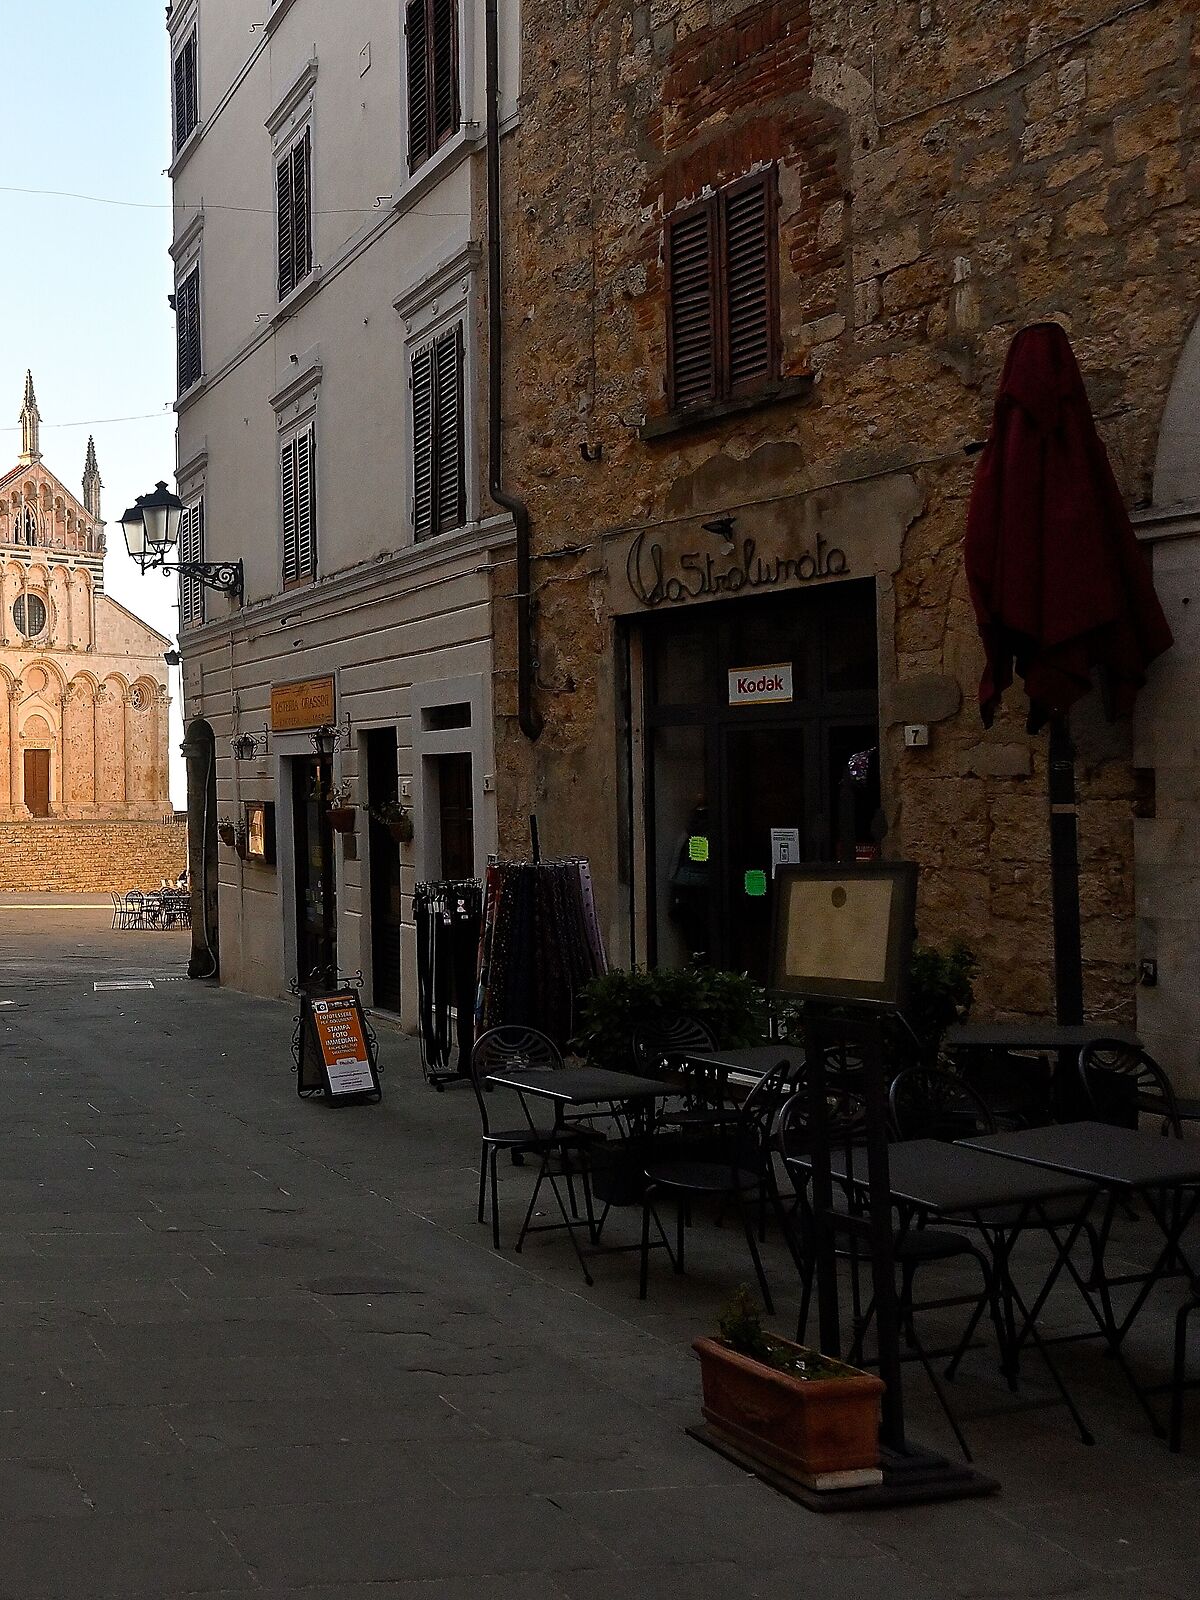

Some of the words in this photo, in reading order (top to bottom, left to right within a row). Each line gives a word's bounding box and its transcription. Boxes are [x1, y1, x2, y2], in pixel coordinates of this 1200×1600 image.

[737, 674, 784, 694] Kodak
[911, 729, 920, 744] 7
[326, 1024, 351, 1033] STAMPA
[332, 1031, 348, 1039] FOTO
[325, 1036, 359, 1046] IMMEDIATA
